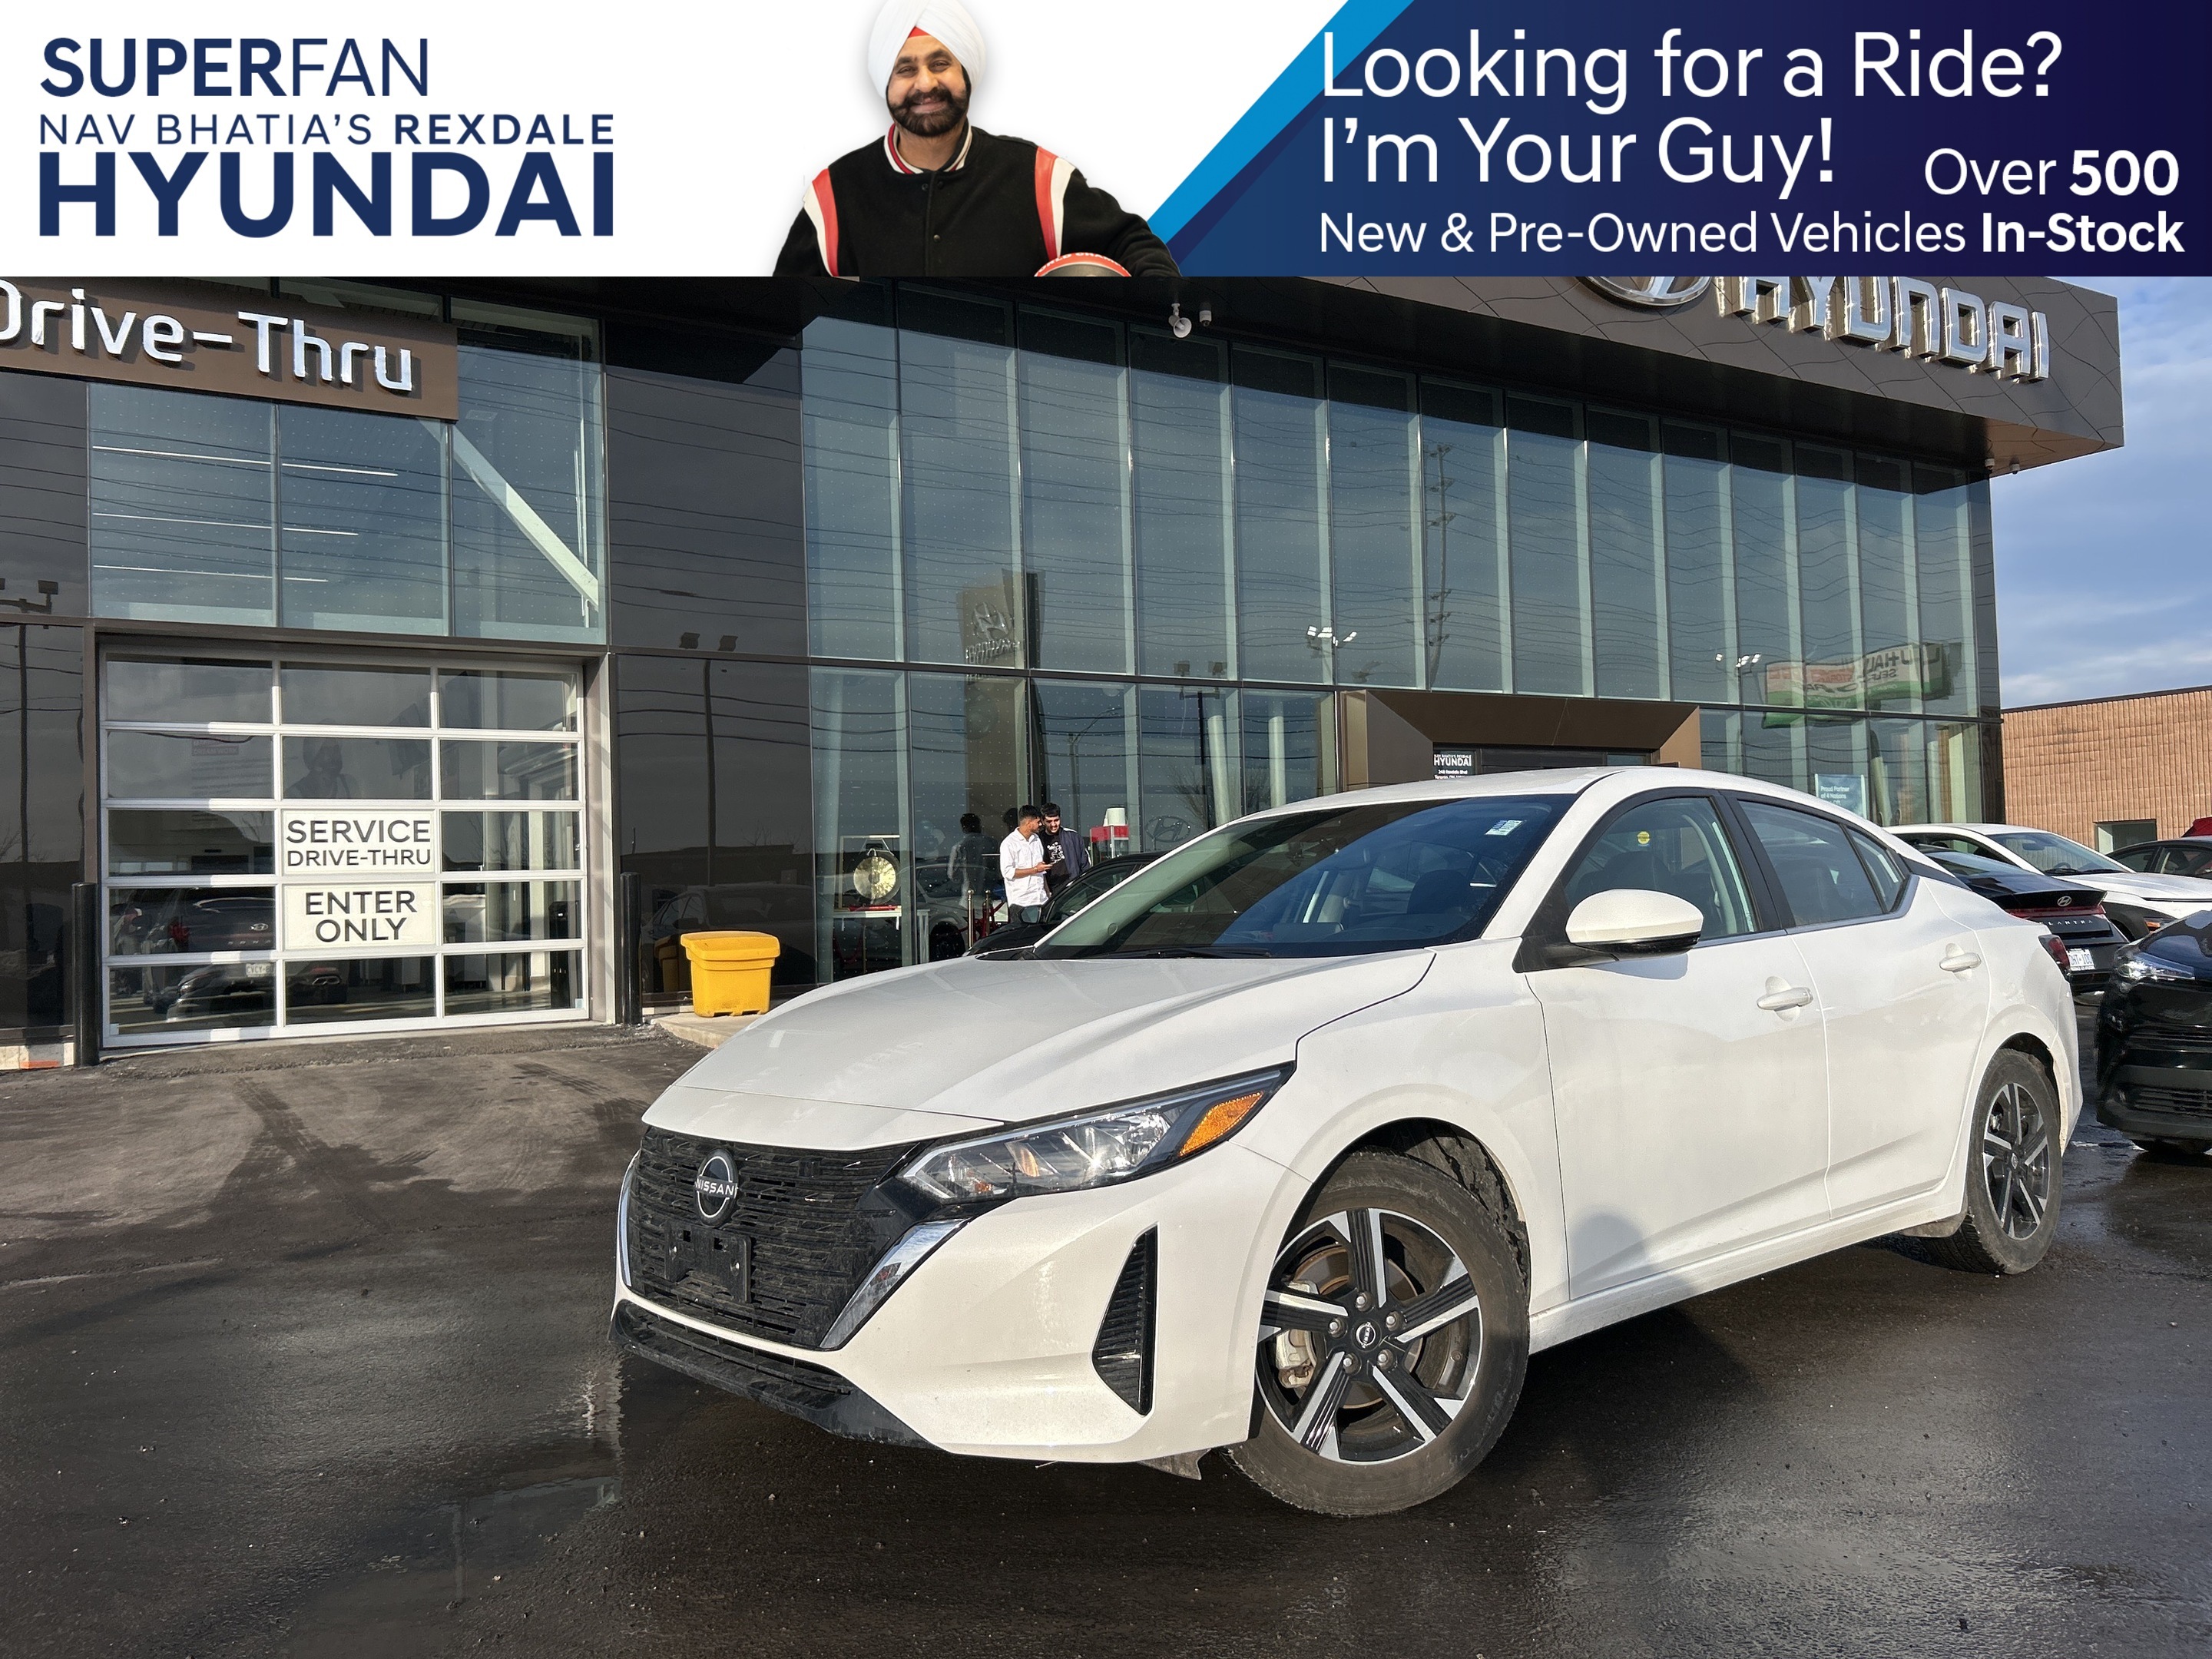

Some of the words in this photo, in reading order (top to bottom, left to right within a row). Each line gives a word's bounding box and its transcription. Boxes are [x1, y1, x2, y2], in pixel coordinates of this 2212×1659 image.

[1720, 276, 2049, 382] HYUNDAI
[1434, 757, 1472, 767] HYUNDAI
[286, 820, 431, 843] SERVICE
[287, 849, 431, 866] DRIVE-THRU
[306, 890, 417, 916] ENTER
[316, 918, 407, 942] ONLY
[694, 1177, 734, 1197] NISSAN
